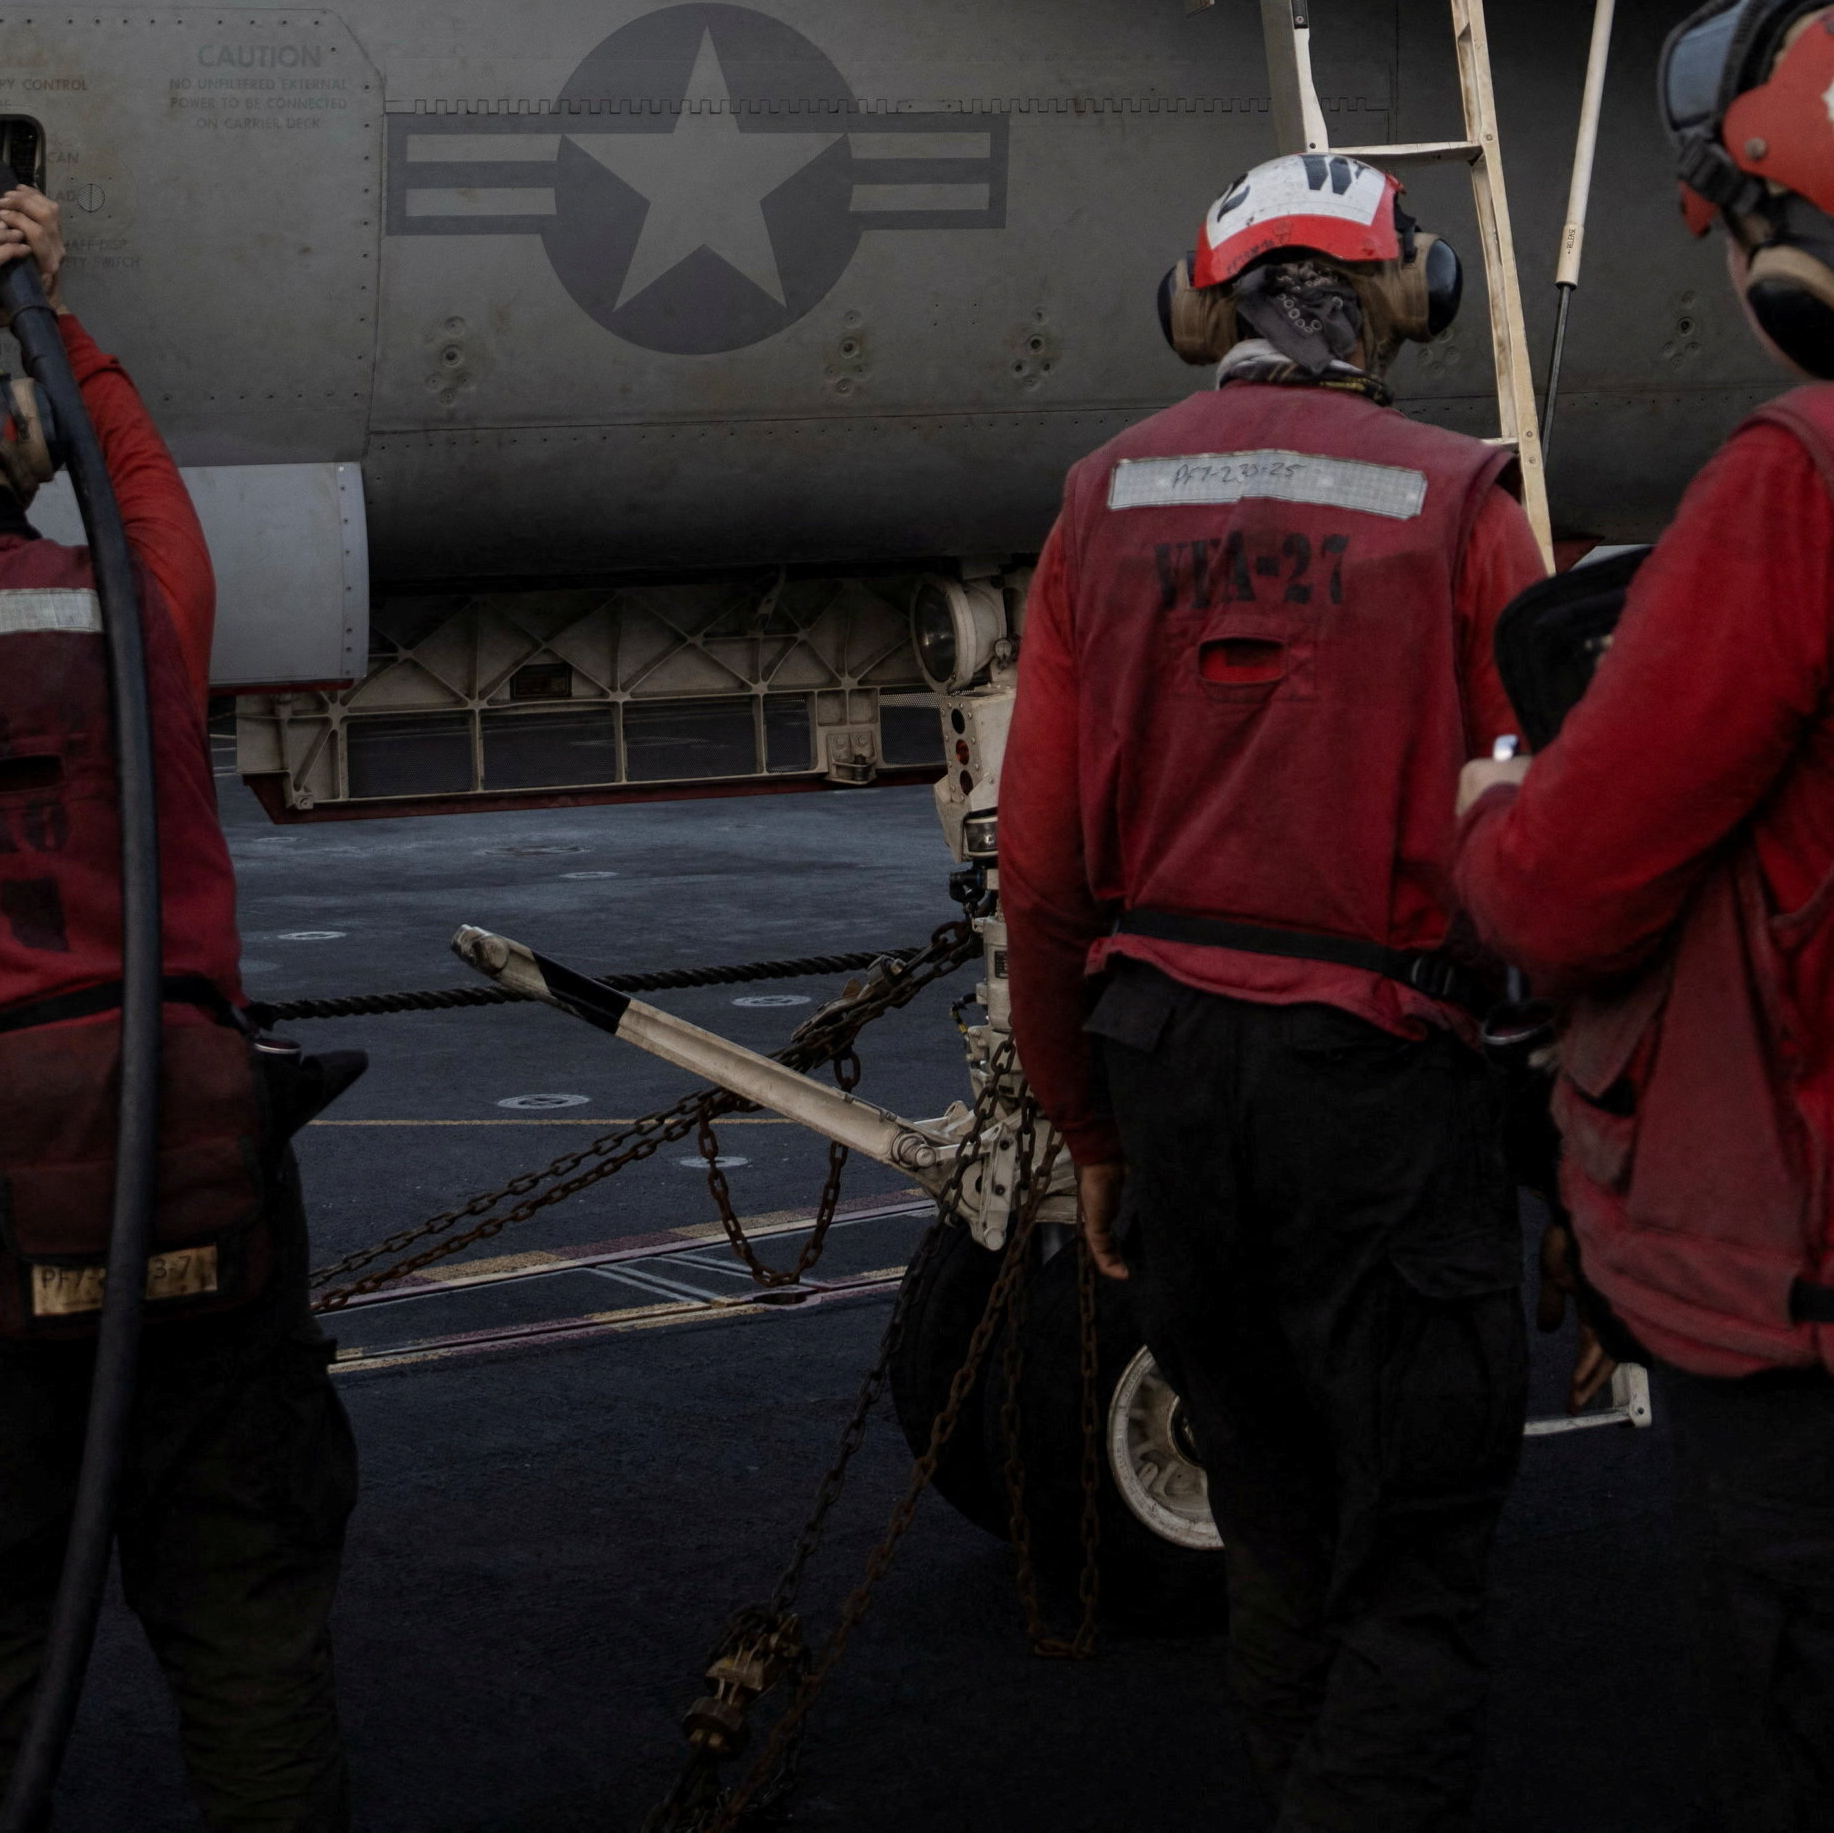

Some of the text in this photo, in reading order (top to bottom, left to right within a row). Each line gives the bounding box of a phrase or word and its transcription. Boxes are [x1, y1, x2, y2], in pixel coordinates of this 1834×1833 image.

[197, 44, 322, 68] CAUTION
[22, 77, 89, 92] CONTROL
[169, 77, 348, 90] NO UNFILTERED EXTERNAL
[169, 96, 348, 110] POWER TO BE CONNECTED
[196, 117, 321, 130] ON CARRIER DECK
[93, 256, 142, 269] SWITCH
[1150, 530, 1351, 608] VFA-27
